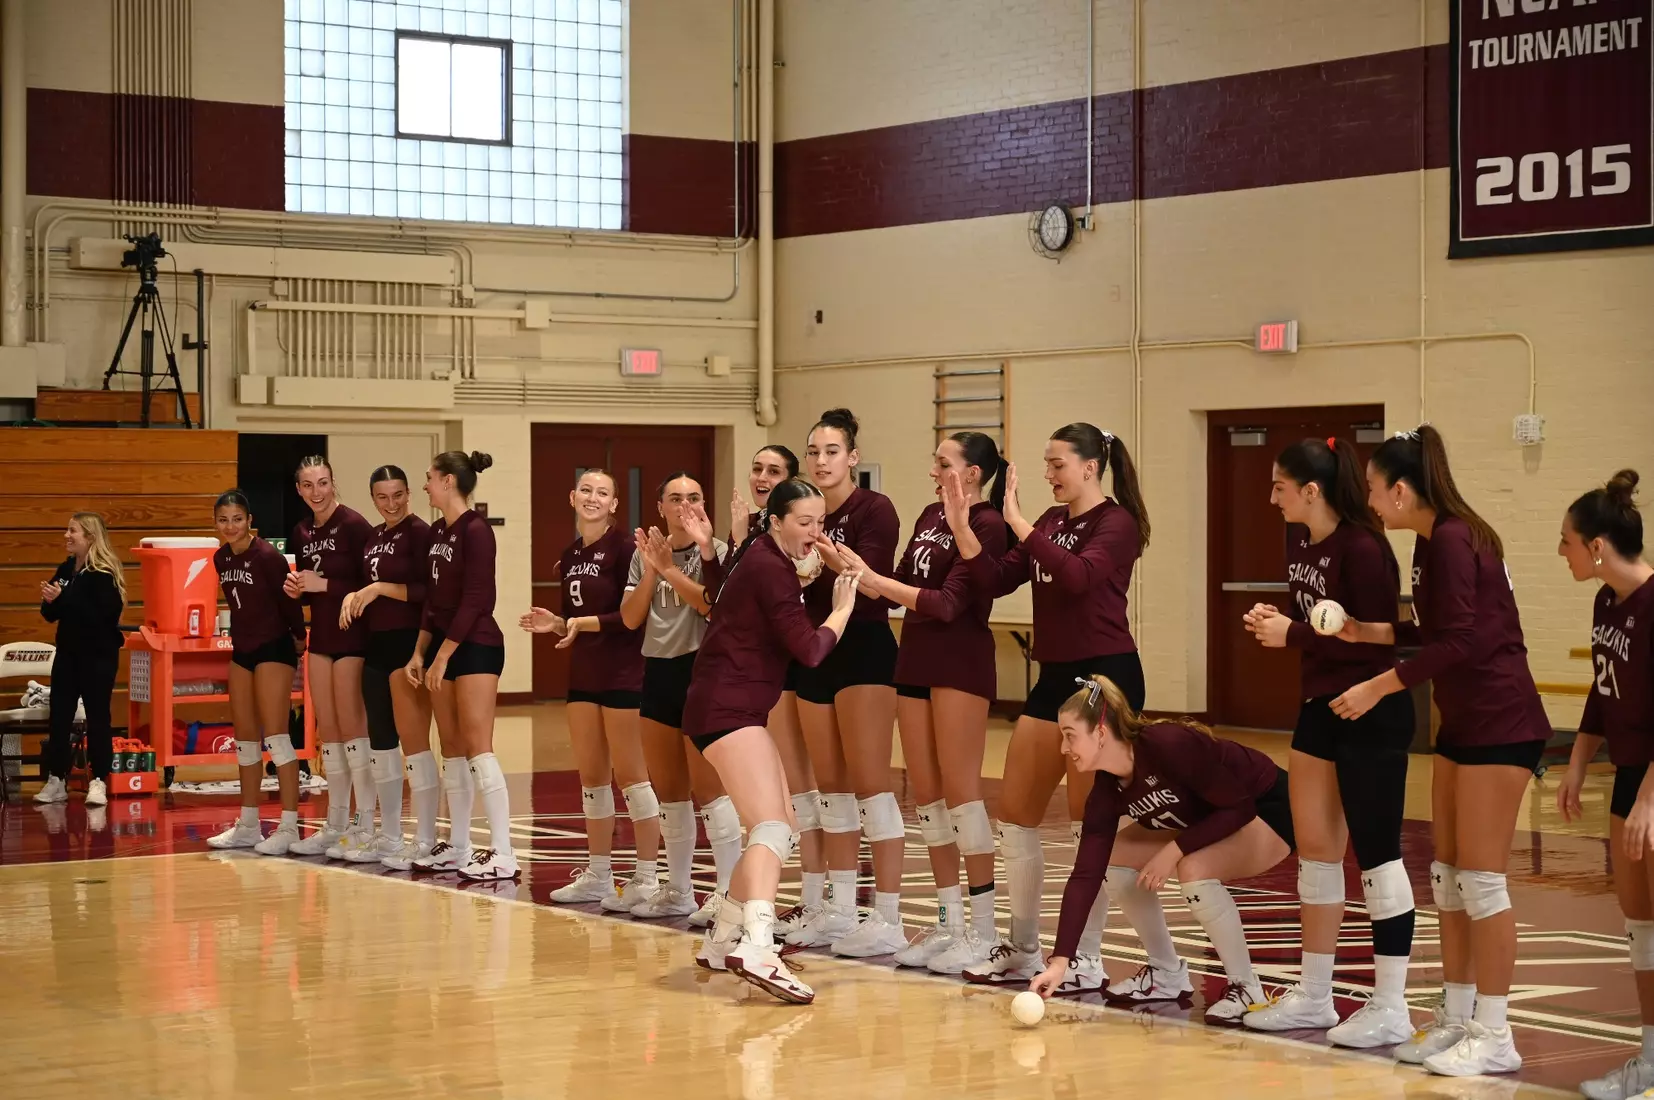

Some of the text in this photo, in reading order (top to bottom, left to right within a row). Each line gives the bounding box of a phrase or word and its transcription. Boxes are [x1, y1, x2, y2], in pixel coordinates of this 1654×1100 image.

[1468, 16, 1643, 70] TOURNAMENT
[1475, 143, 1632, 206] 2015
[1260, 323, 1286, 350] EXIT
[311, 554, 324, 576] 2
[428, 542, 453, 563] ALUKIS
[912, 545, 931, 579] 14
[370, 557, 380, 582] 3
[432, 560, 439, 586] 4
[1288, 562, 1326, 597] SALUKIS
[231, 586, 241, 609] 1
[569, 580, 584, 607] 9
[1592, 624, 1631, 662] SALUKIS
[1596, 653, 1621, 700] 21
[126, 758, 136, 769] G
[128, 775, 142, 791] G
